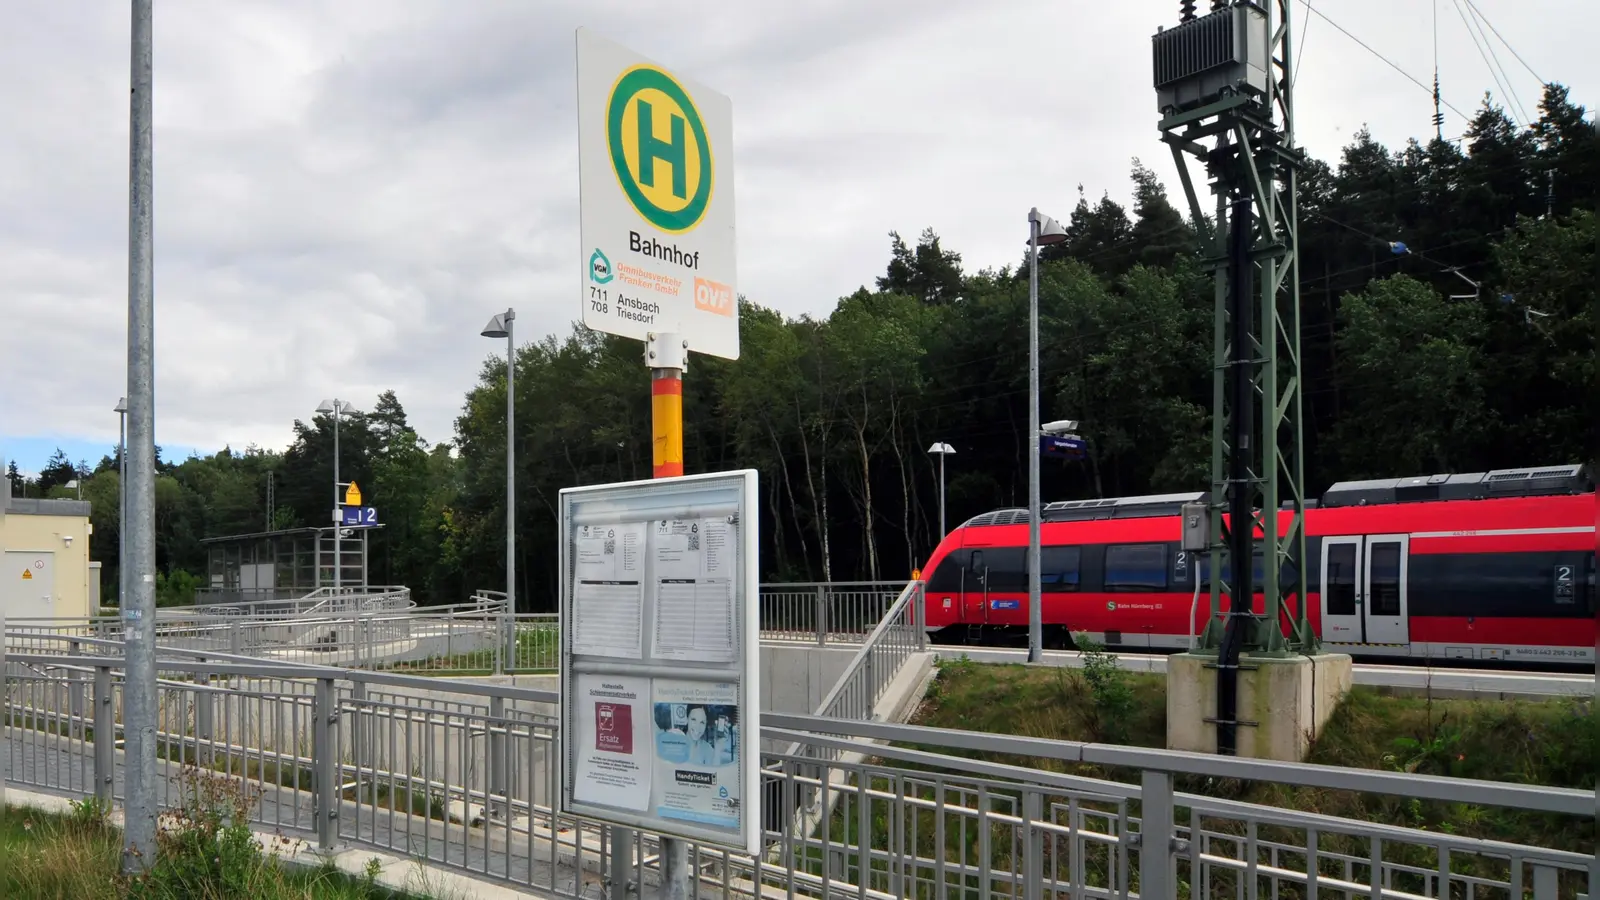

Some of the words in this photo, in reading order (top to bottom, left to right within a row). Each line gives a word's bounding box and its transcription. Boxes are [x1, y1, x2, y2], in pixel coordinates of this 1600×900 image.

[637, 98, 687, 200] H
[629, 230, 699, 270] Bahnhof
[594, 263, 607, 274] VGN
[617, 262, 682, 287] Omnibusverkehr
[619, 272, 653, 289] Franken
[655, 281, 679, 296] GmbH
[590, 286, 608, 301] 711
[617, 293, 660, 314] Ansbach
[591, 300, 609, 314] 708
[616, 306, 654, 325] Triesdorf
[367, 507, 376, 522] 2
[1177, 551, 1186, 564] 2
[1558, 566, 1570, 581] 2
[599, 733, 620, 743] Ersatz
[676, 772, 711, 783] HandyTicket
